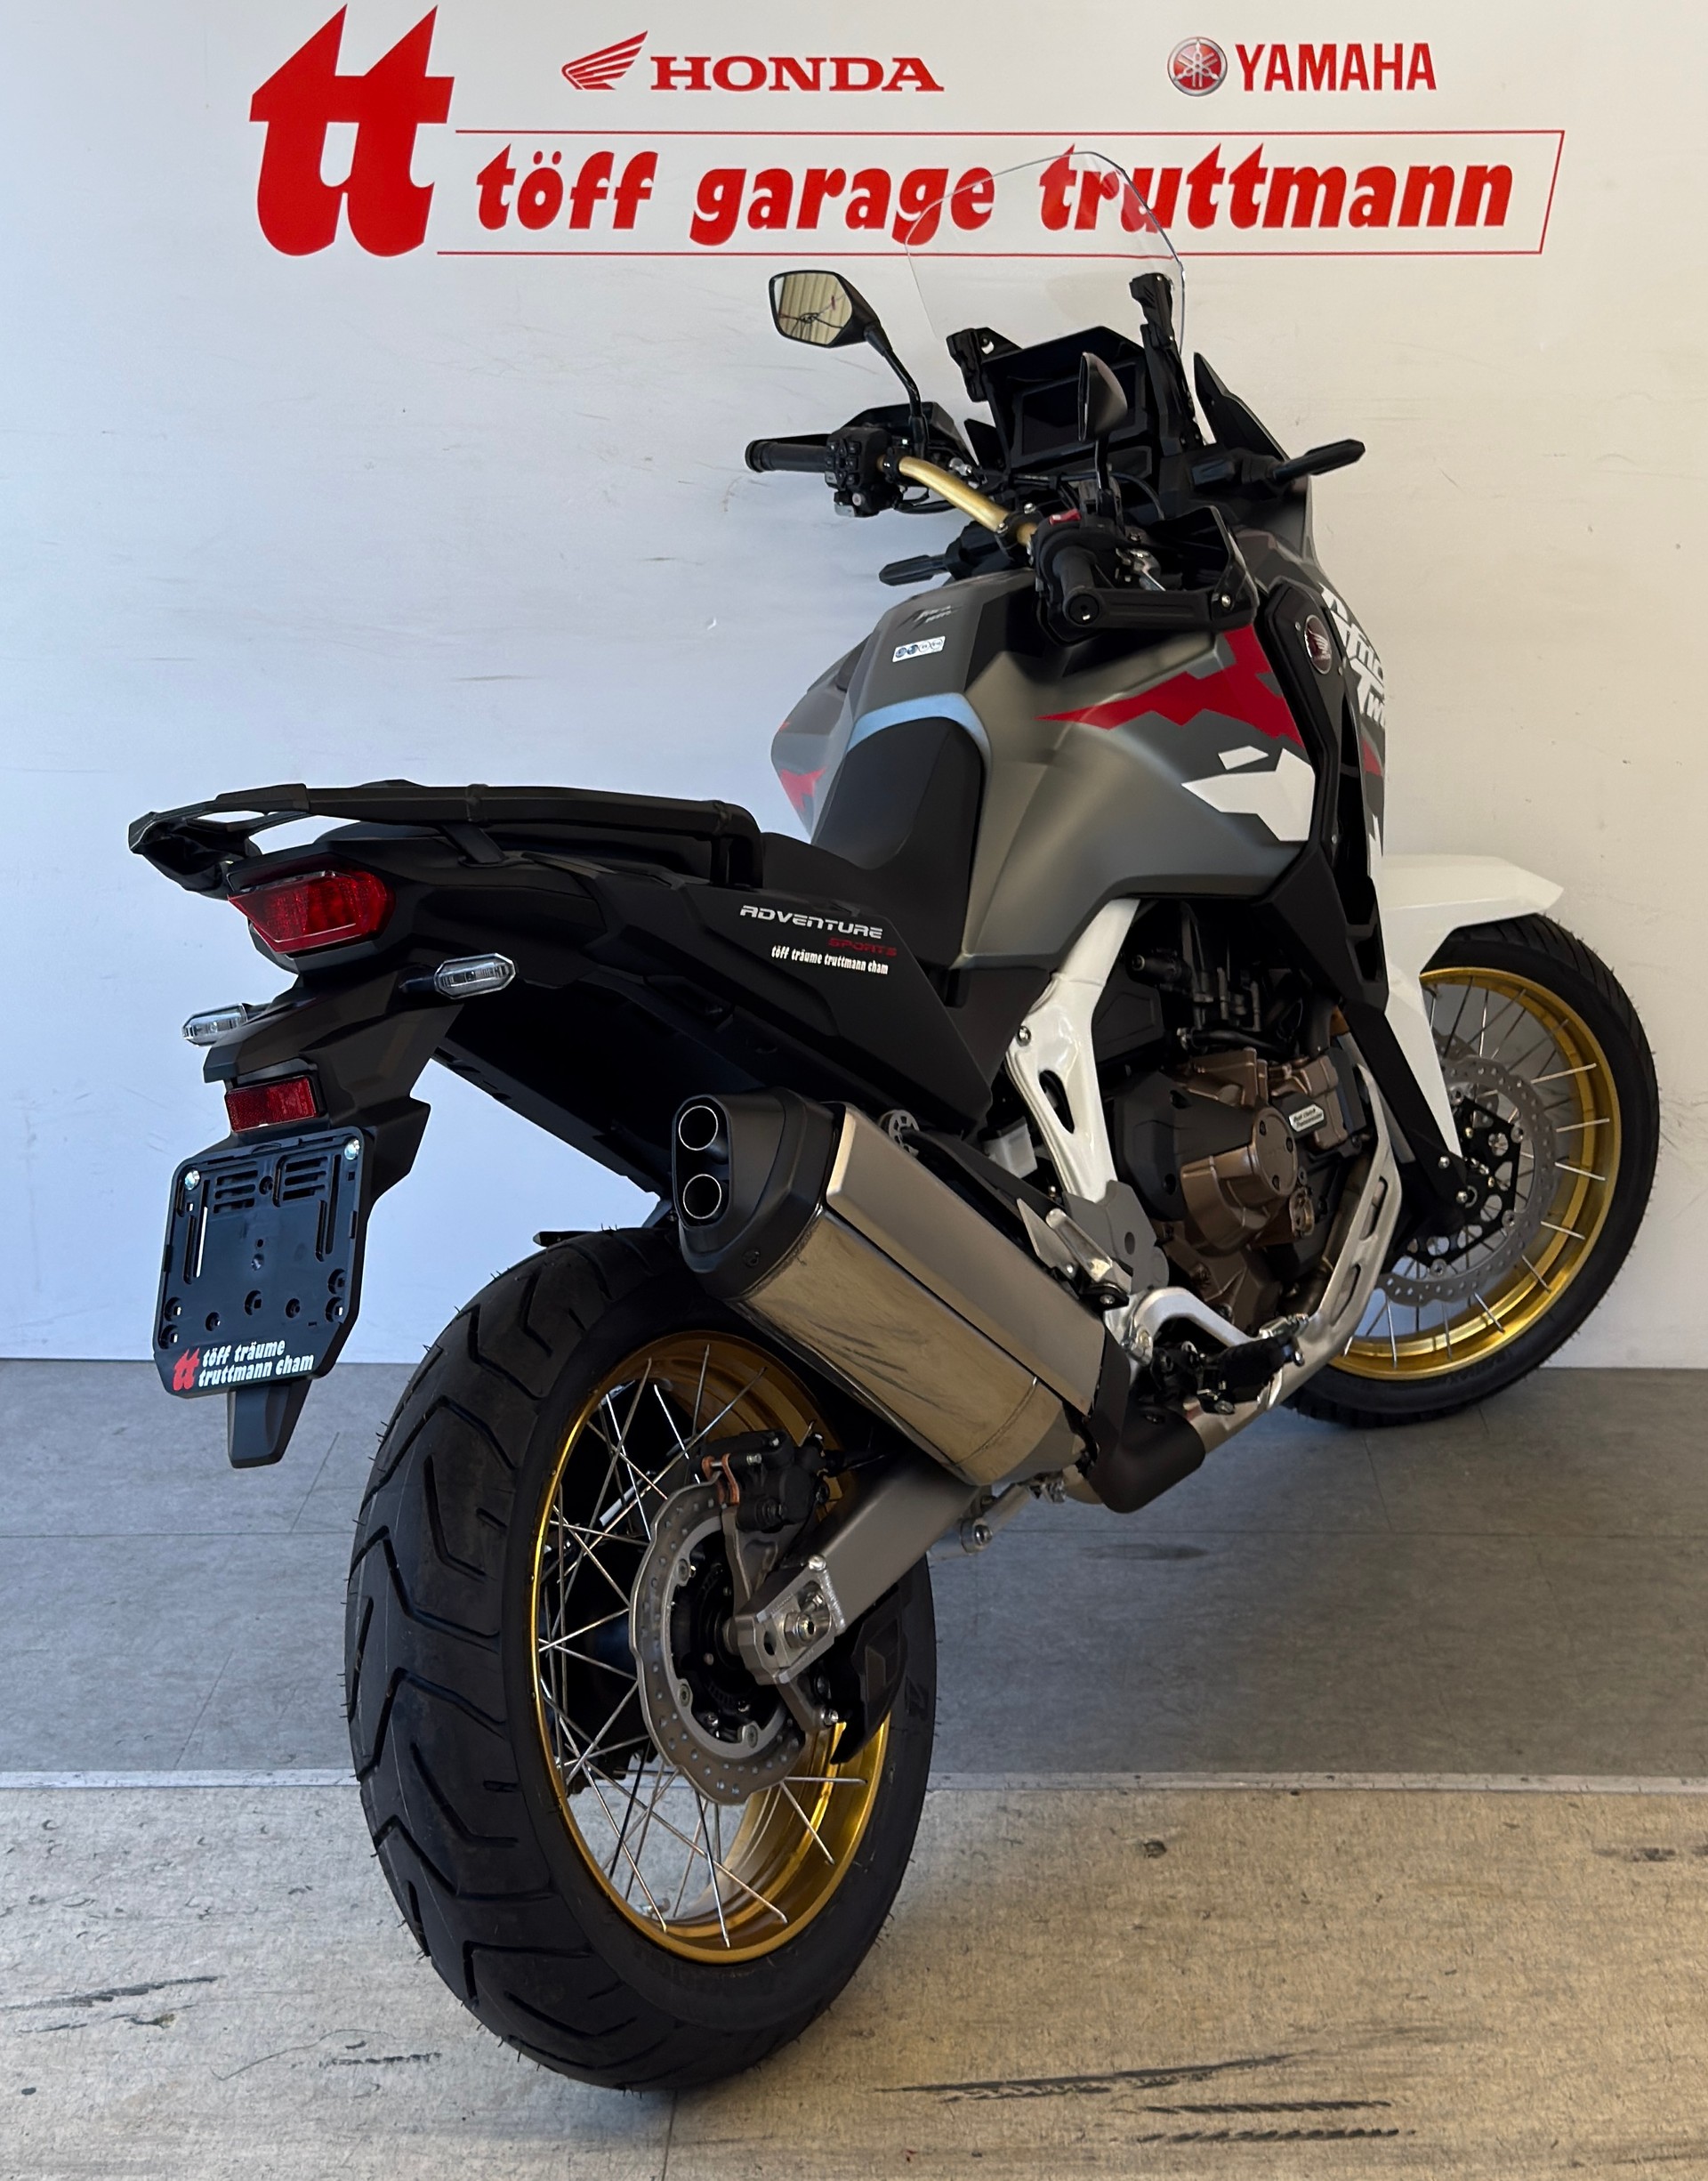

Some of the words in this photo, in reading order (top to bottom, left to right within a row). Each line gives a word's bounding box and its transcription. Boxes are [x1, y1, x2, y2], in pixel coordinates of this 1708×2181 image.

[650, 57, 944, 93] HONDA
[1236, 43, 1437, 92] YAMAHA
[477, 143, 658, 231] töff
[690, 167, 995, 246] garage
[1040, 143, 1513, 232] truttmann
[740, 905, 882, 939] ADVENTURE
[771, 945, 790, 959] töff
[791, 949, 823, 965] träume
[824, 953, 866, 972] truttmann
[867, 960, 889, 974] cham
[828, 937, 897, 957] SPORTS
[198, 1361, 273, 1387] truttmann
[275, 1353, 314, 1376] cham
[202, 1345, 232, 1368] töff
[234, 1339, 286, 1363] träume
